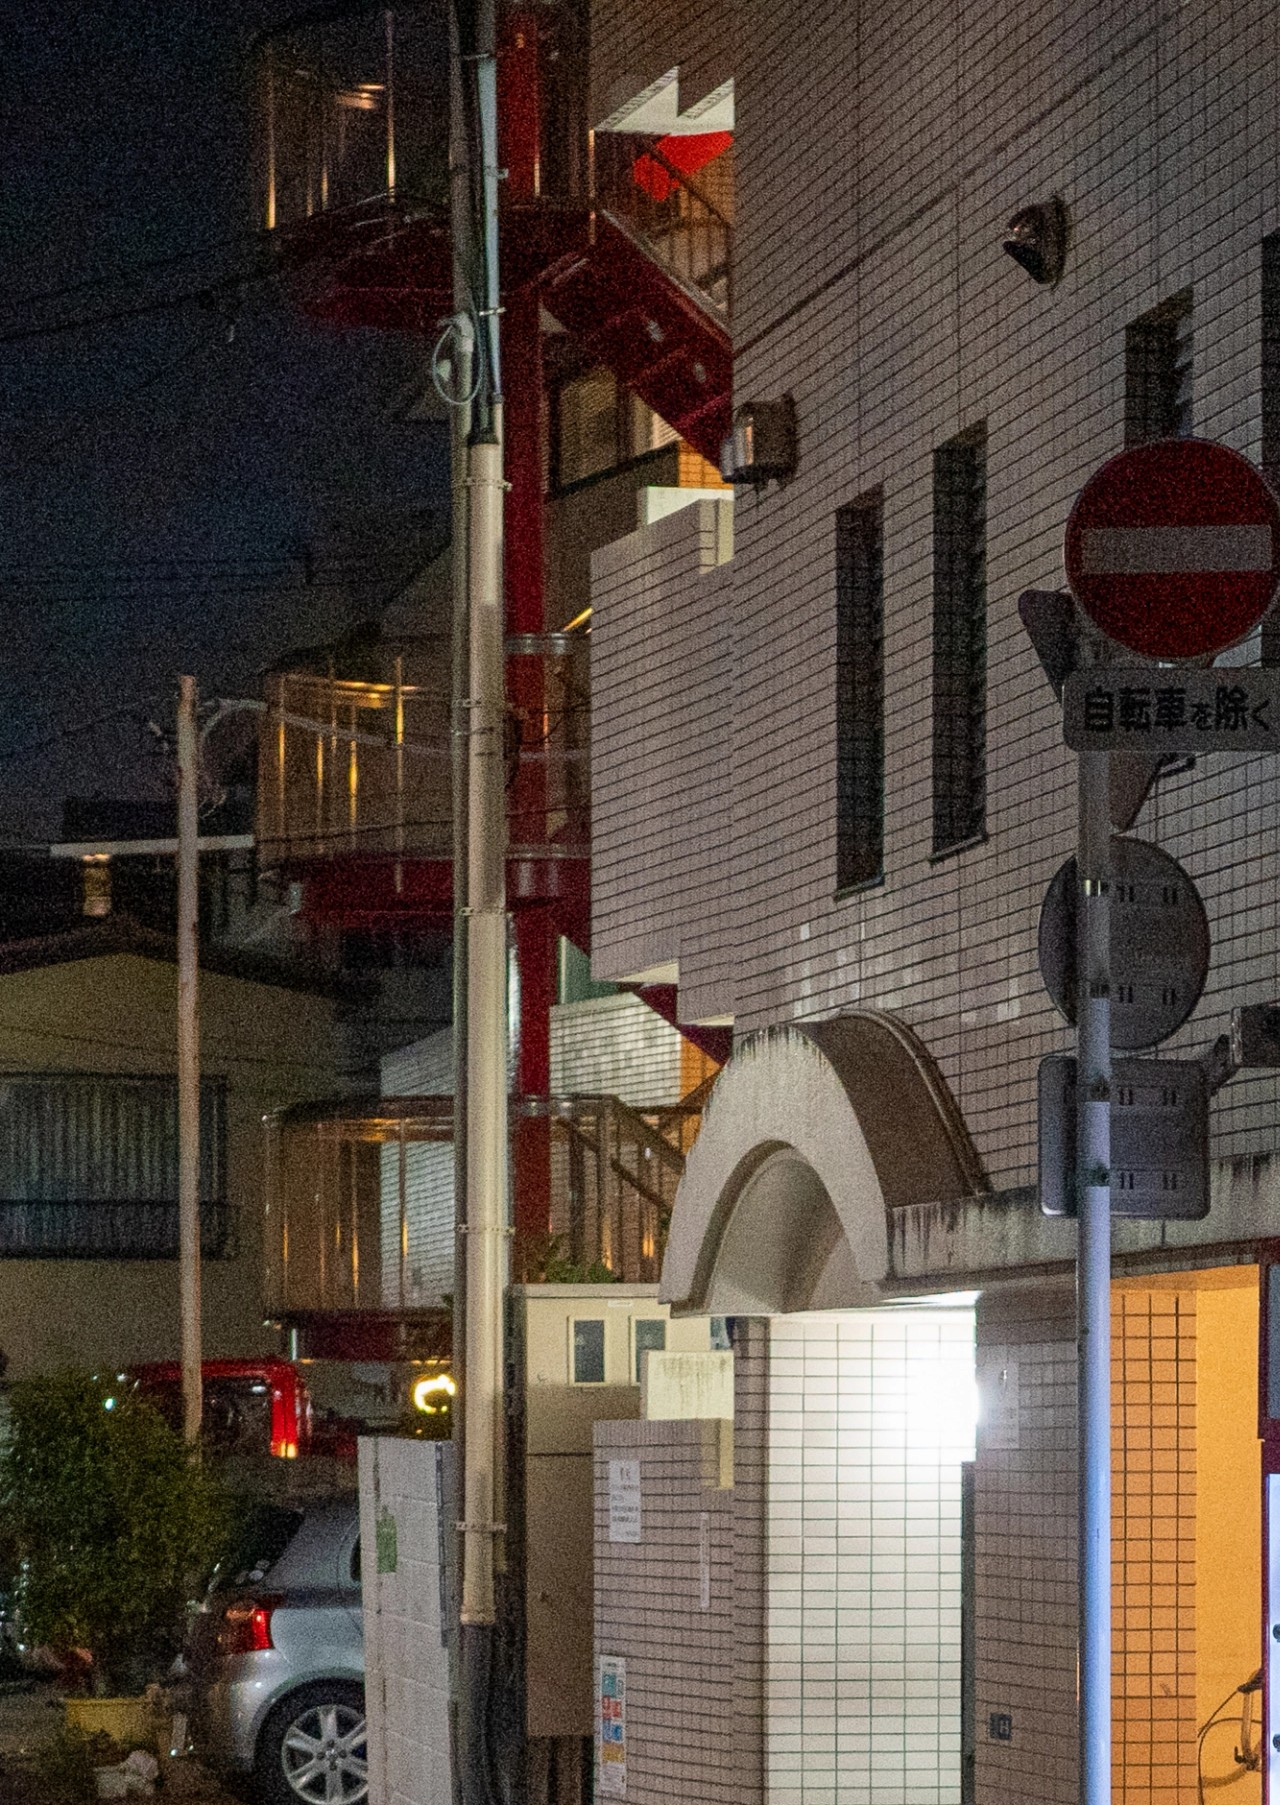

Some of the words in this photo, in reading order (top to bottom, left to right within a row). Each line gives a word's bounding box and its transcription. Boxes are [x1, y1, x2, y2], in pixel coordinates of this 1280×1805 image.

[1085, 686, 1270, 732] 自転車を除く
